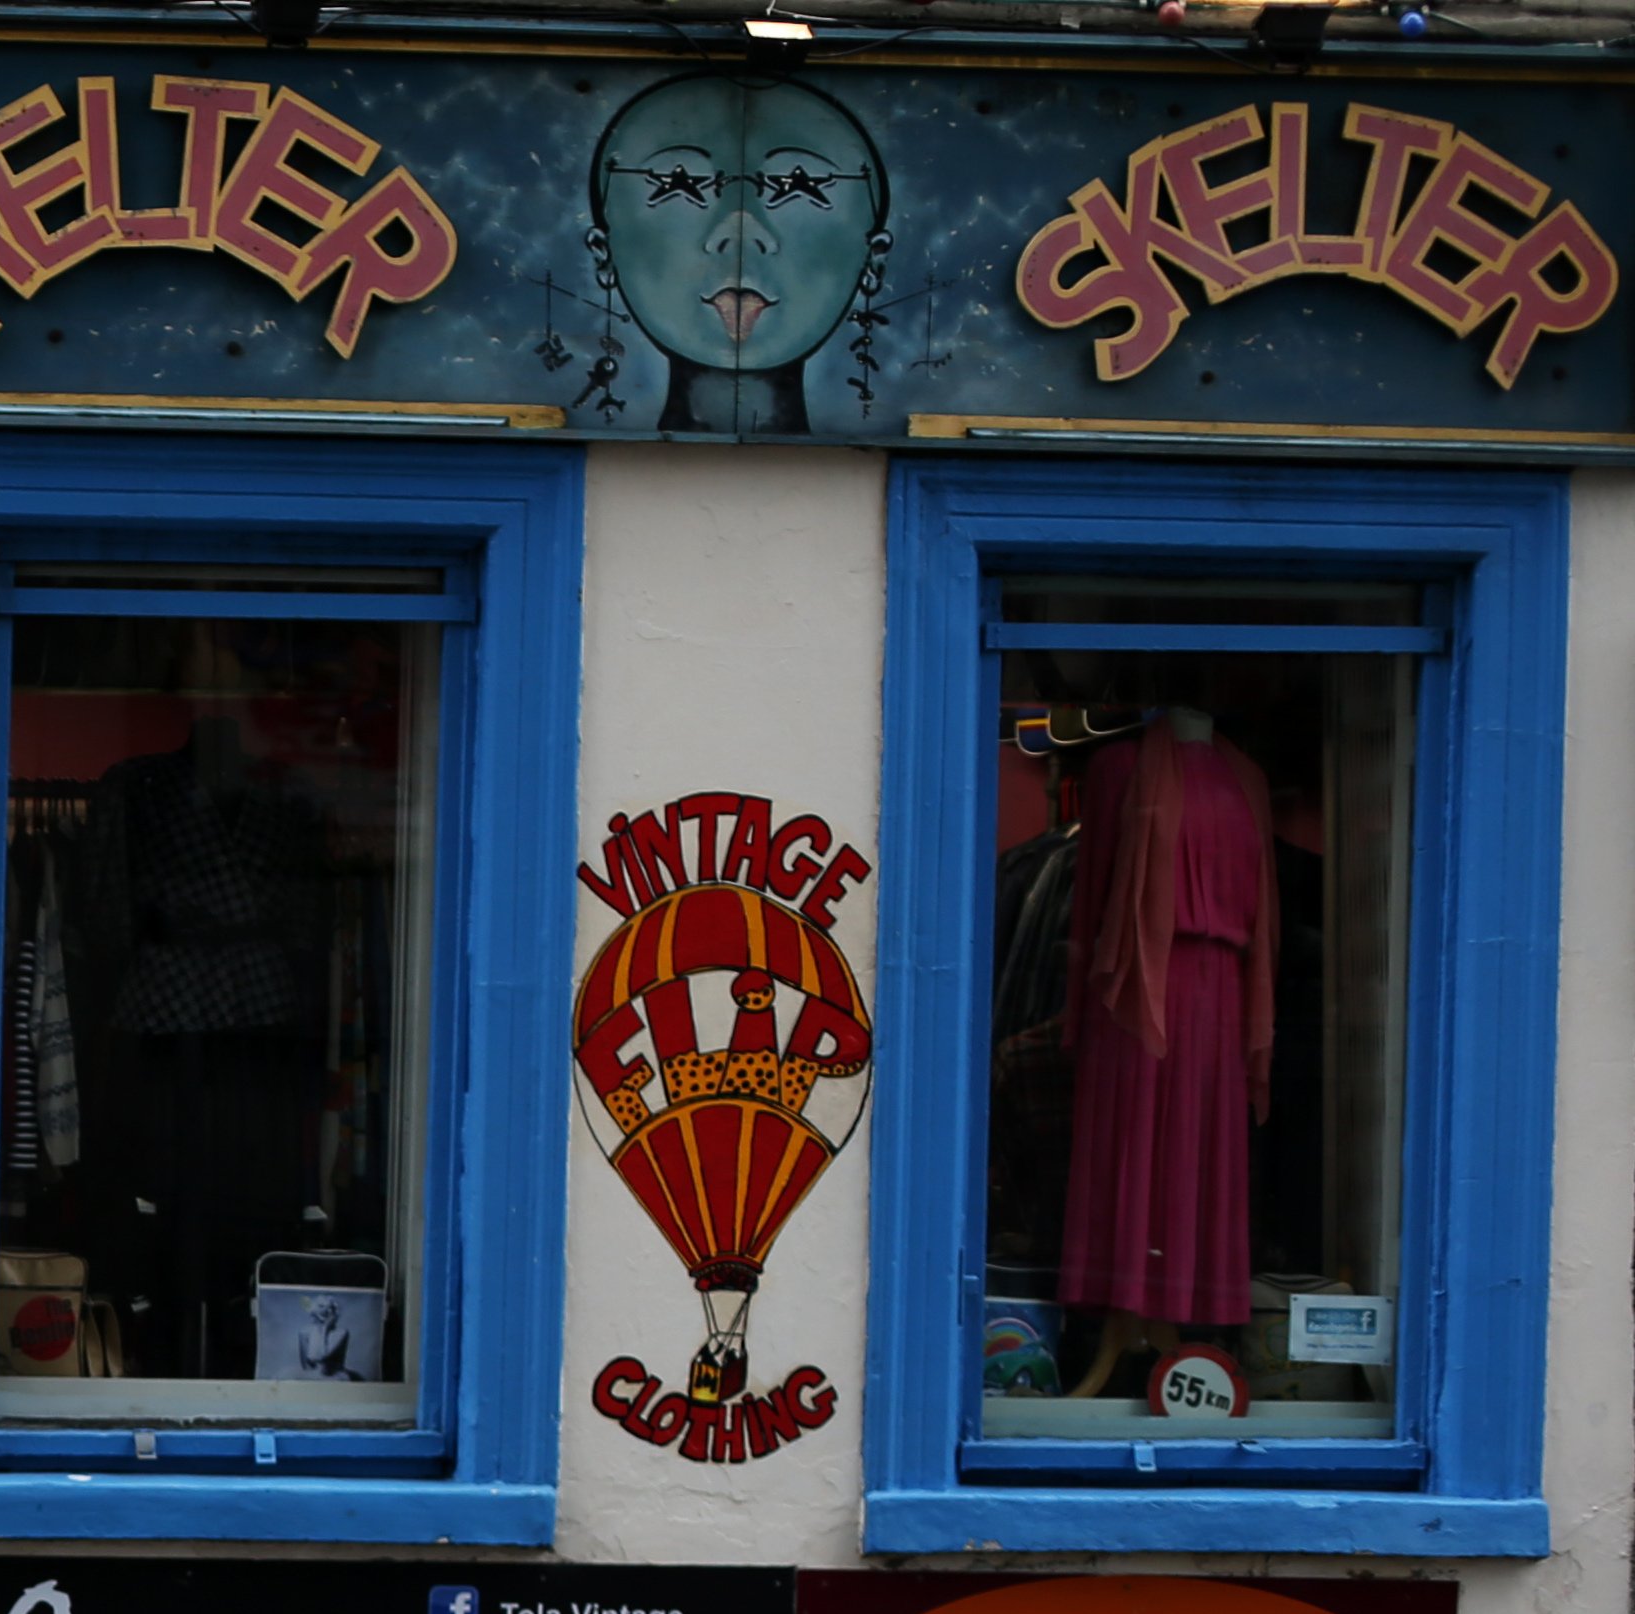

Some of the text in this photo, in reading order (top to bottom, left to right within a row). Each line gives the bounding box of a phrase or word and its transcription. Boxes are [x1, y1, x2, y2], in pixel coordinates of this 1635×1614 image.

[1016, 101, 1619, 391] SKELTER
[593, 1355, 837, 1463] CLOTHING
[1167, 1370, 1231, 1411] 55 km
